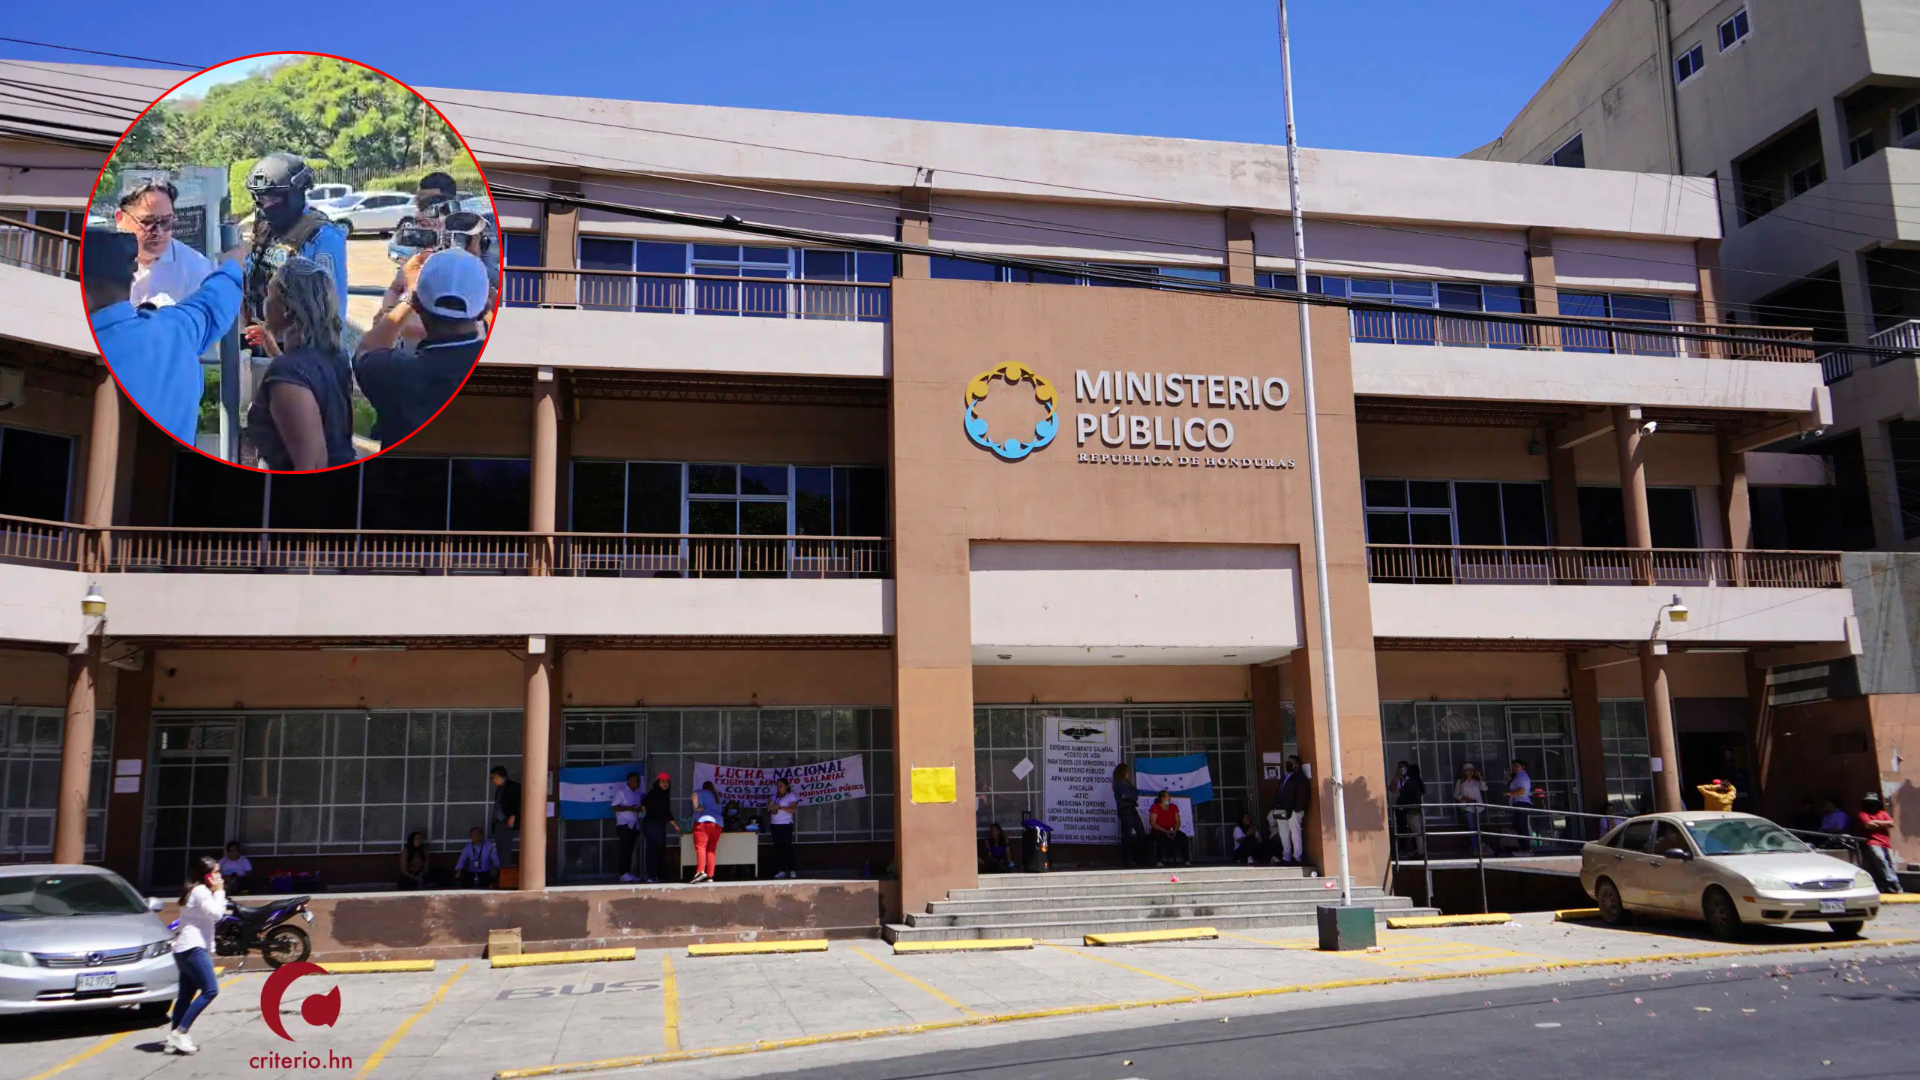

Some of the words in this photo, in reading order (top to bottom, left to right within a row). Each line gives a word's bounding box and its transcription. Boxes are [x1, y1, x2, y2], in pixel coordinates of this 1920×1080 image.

[1075, 369, 1290, 409] MINISTERIO
[1076, 406, 1234, 450] PÚBLICO
[1078, 453, 1173, 465] REPUBLICA
[1178, 457, 1200, 467] DE
[1205, 458, 1296, 469] HONDURAS
[714, 767, 765, 779] LUCHA
[773, 760, 846, 779] NACIONAL
[714, 777, 755, 786] EXIGIMOS
[758, 777, 800, 787] AUMTO
[803, 772, 845, 783] SALARIAL
[725, 786, 771, 794] COSTO
[801, 782, 833, 791] VIDA
[798, 788, 837, 798] MINISTERIO
[808, 792, 852, 804] TODOS
[495, 978, 661, 1001] BUS
